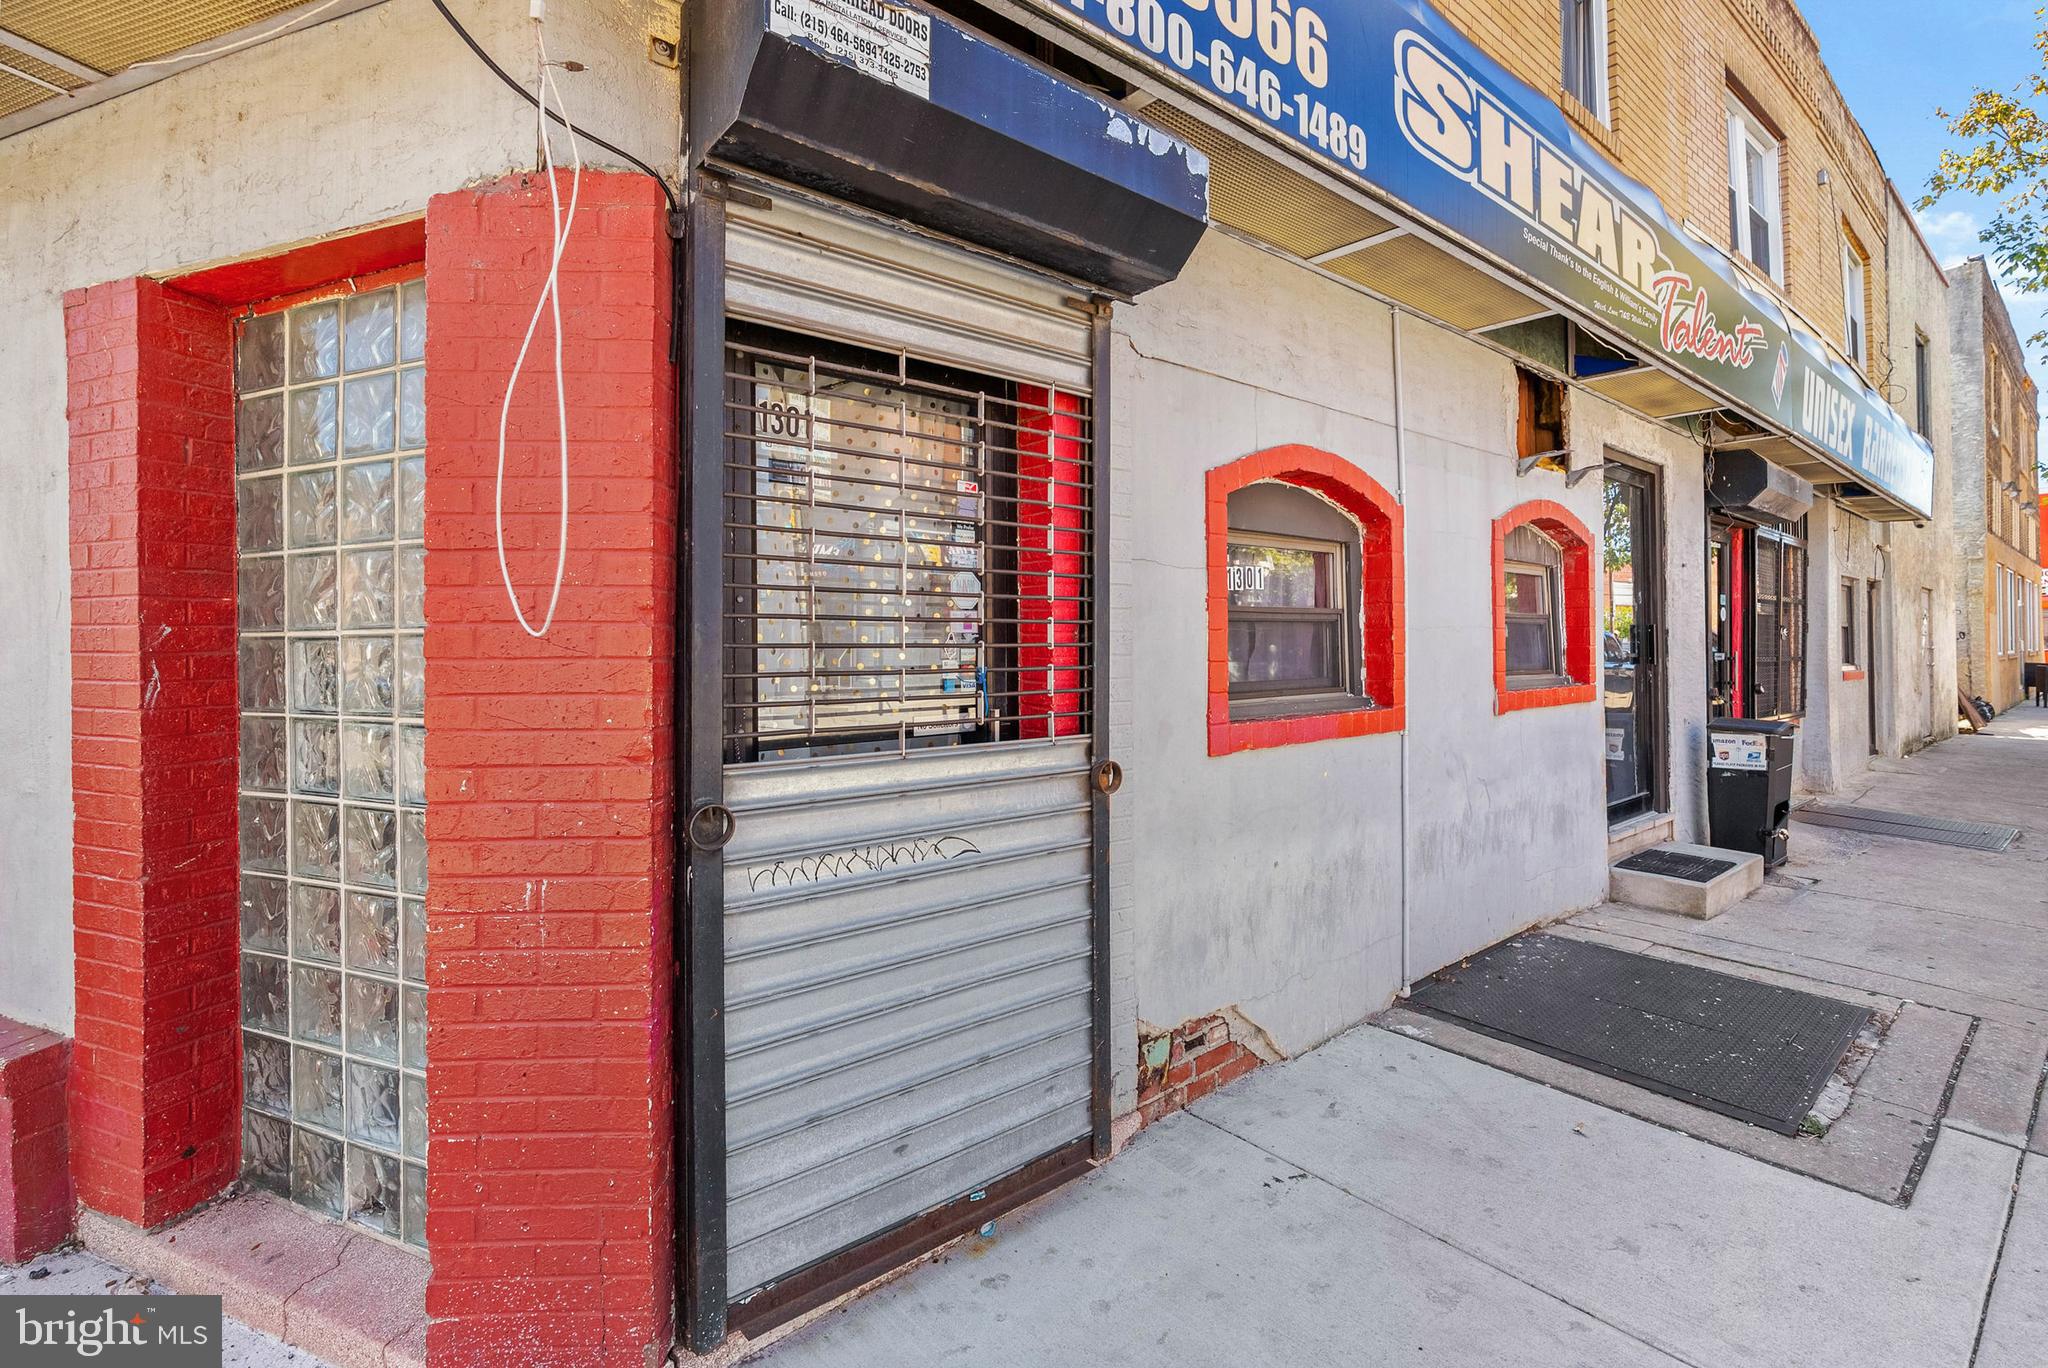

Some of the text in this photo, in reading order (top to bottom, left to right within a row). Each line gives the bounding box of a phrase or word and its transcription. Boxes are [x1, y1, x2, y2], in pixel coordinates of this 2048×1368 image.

[774, 0, 927, 81] Call: (215) 464-5694 425-2753
[879, 25, 908, 44] SERVICES
[889, 10, 928, 42] DOORS
[859, 56, 899, 80] 373-3405
[1396, 33, 1659, 306] SHEAR
[1522, 227, 1549, 253] Special
[1549, 244, 1575, 269] Thank's
[1575, 261, 1582, 273] to
[1583, 267, 1592, 281] the
[1593, 273, 1614, 294] English
[1615, 288, 1619, 298] &
[1652, 270, 1765, 369] Talent
[1802, 365, 1857, 461] UNISEX
[1227, 567, 1262, 590] 1301
